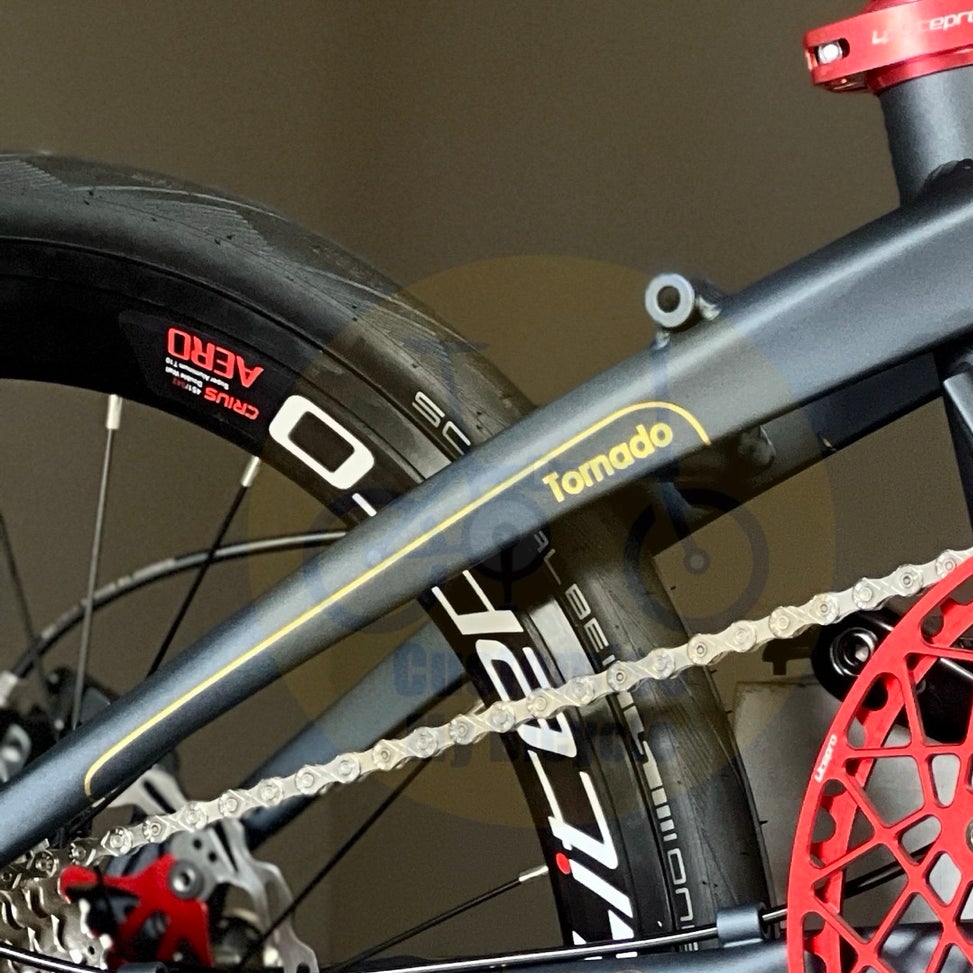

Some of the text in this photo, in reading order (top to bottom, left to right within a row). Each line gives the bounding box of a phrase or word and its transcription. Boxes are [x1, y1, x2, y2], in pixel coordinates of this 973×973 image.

[167, 328, 264, 388] AERO
[203, 387, 259, 420] CRIUS
[542, 422, 674, 503] Tornado
